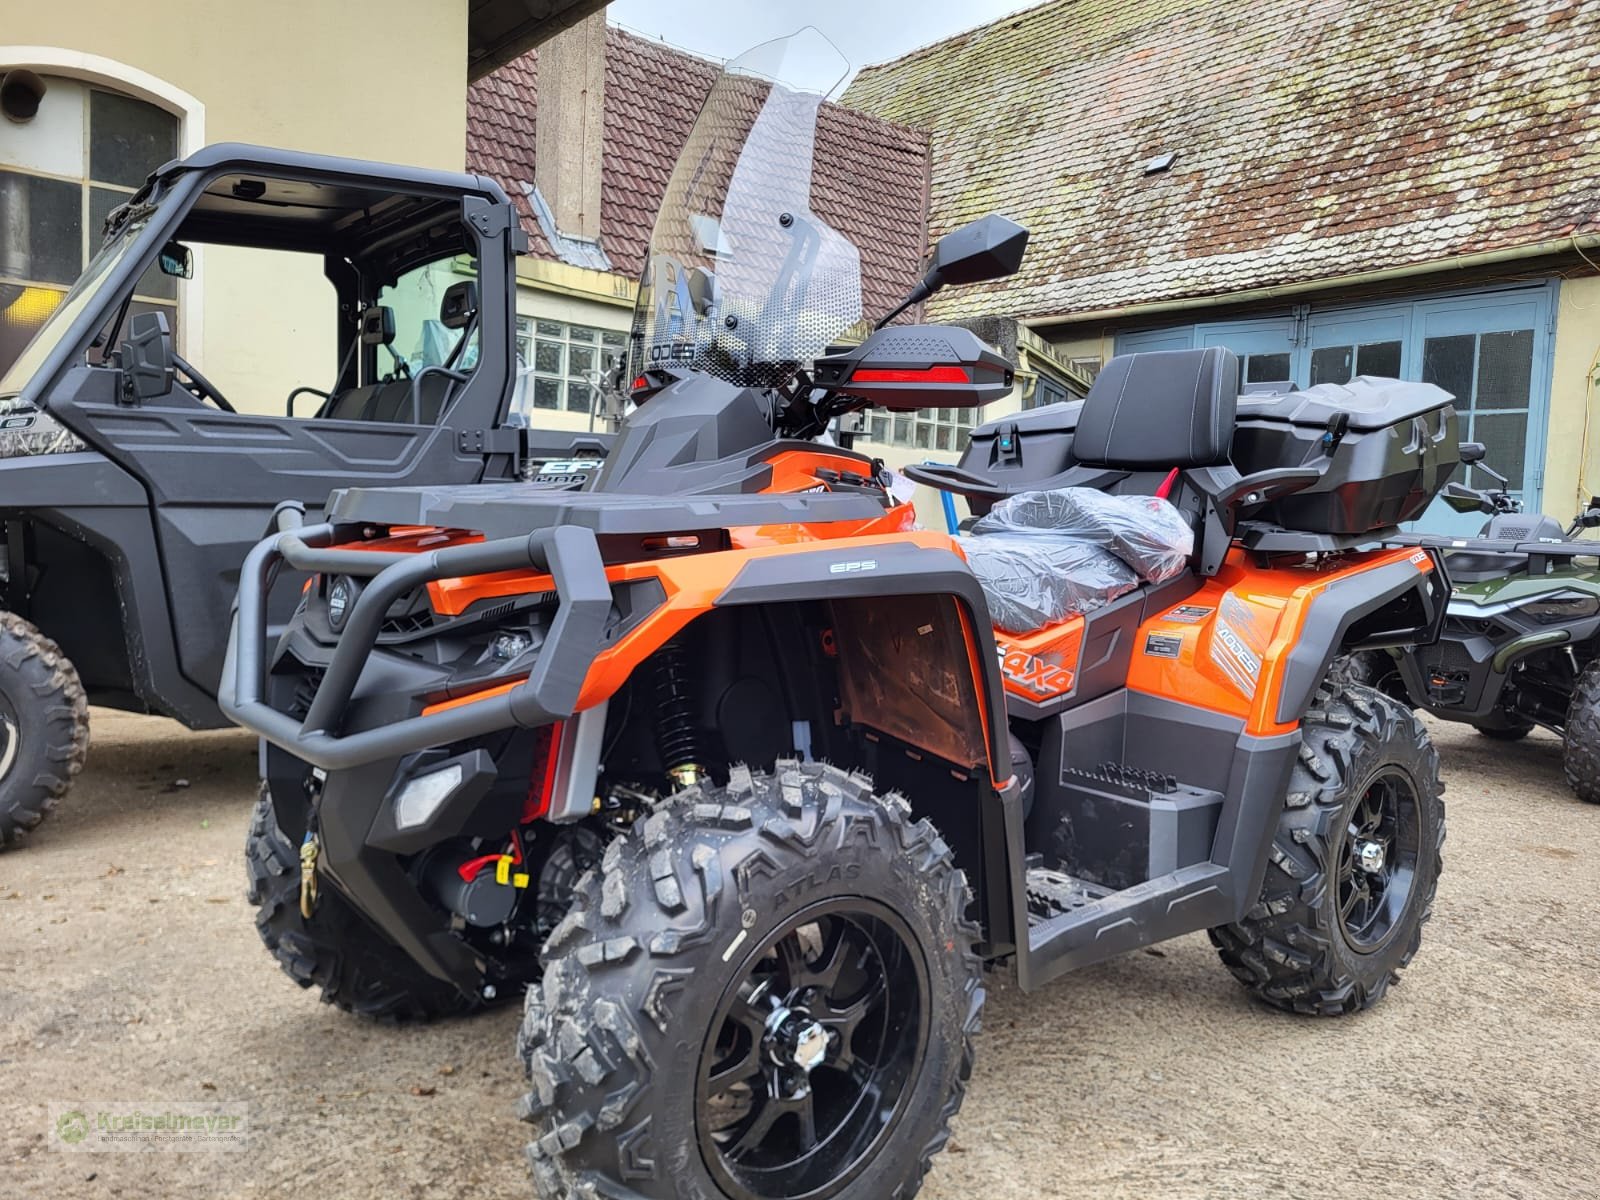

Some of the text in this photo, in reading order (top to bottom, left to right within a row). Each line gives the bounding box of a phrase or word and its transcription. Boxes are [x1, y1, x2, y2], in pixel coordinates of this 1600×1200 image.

[829, 559, 877, 574] EPS
[1218, 628, 1259, 674] AODES
[772, 862, 861, 910] ATLAS
